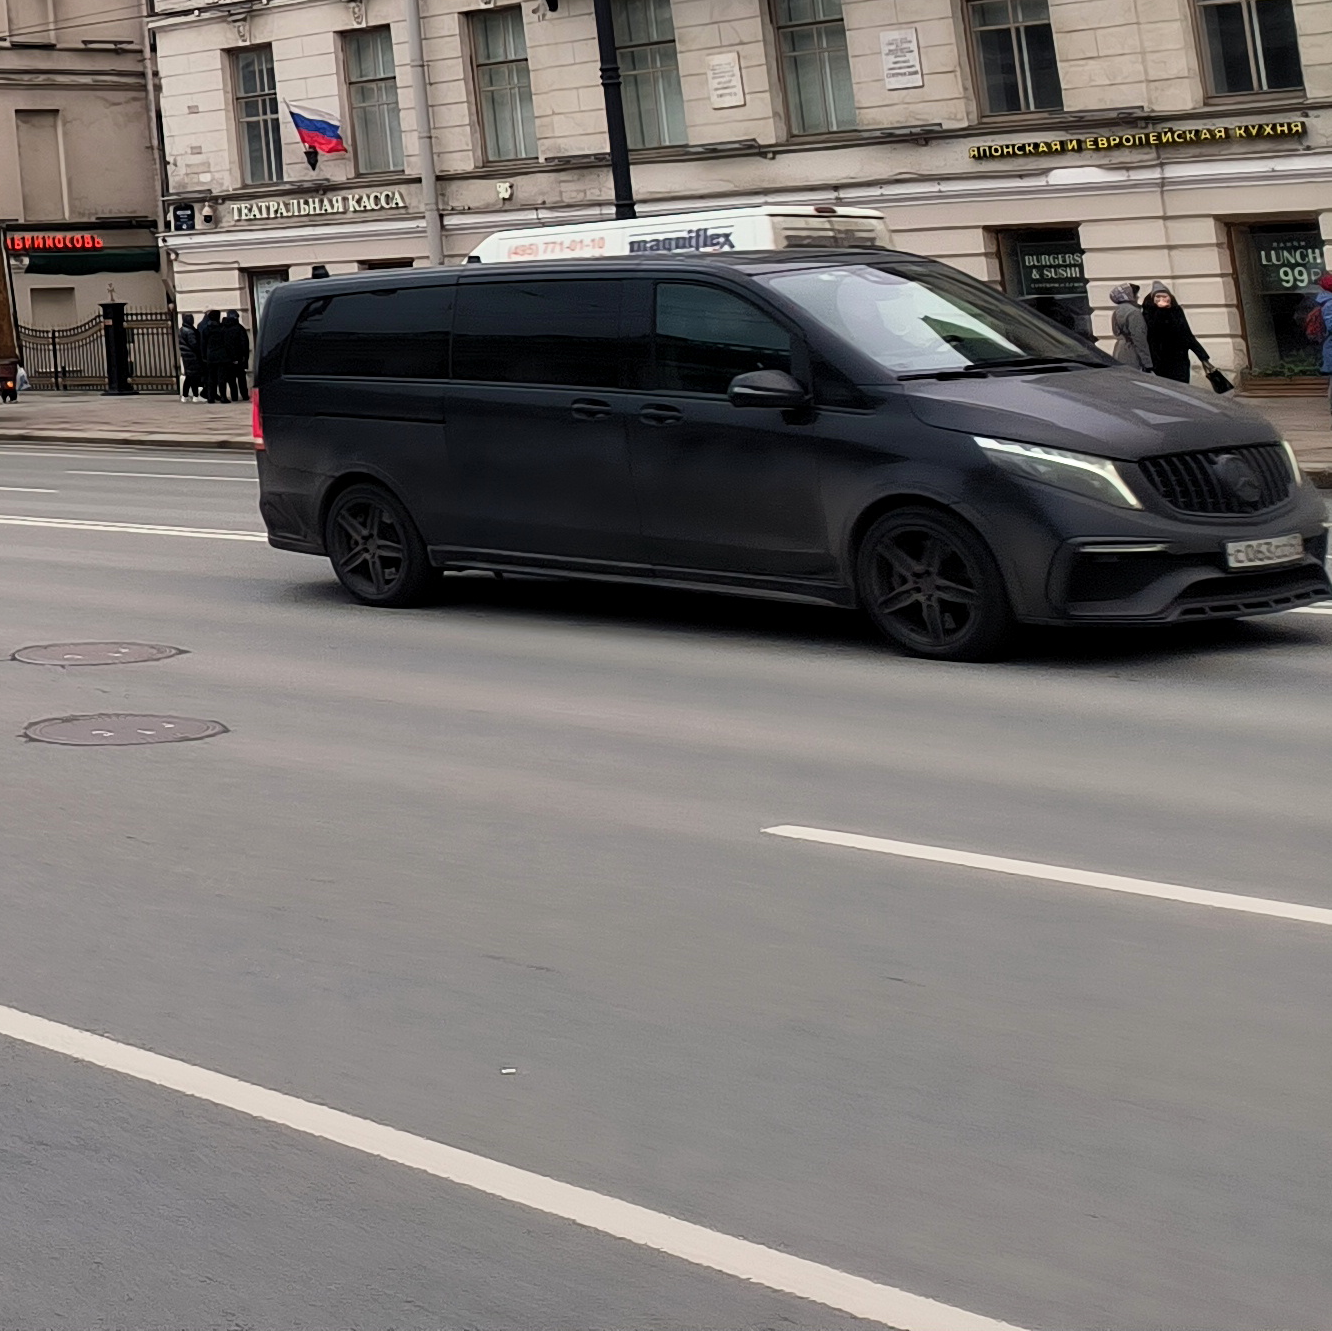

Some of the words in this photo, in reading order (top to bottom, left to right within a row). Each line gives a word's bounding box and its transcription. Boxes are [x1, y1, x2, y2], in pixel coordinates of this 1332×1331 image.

[969, 140, 1062, 159] ЯПОНСКАЯ
[1067, 139, 1079, 151] И
[1086, 126, 1226, 149] ЕВРОПЕЙСКАЯ
[1235, 121, 1303, 138] КУХНЯ
[231, 196, 345, 220] ТЕАТРАЛЬНАЯ
[348, 189, 405, 212] КАССА
[508, 243, 539, 259] (495)
[543, 236, 606, 254] 771-01-10
[628, 227, 736, 254] magniflex
[1024, 253, 1082, 266] BURGERS
[1260, 248, 1322, 265] LUNCH
[1031, 268, 1040, 279] &
[1043, 266, 1080, 279] SUSHI
